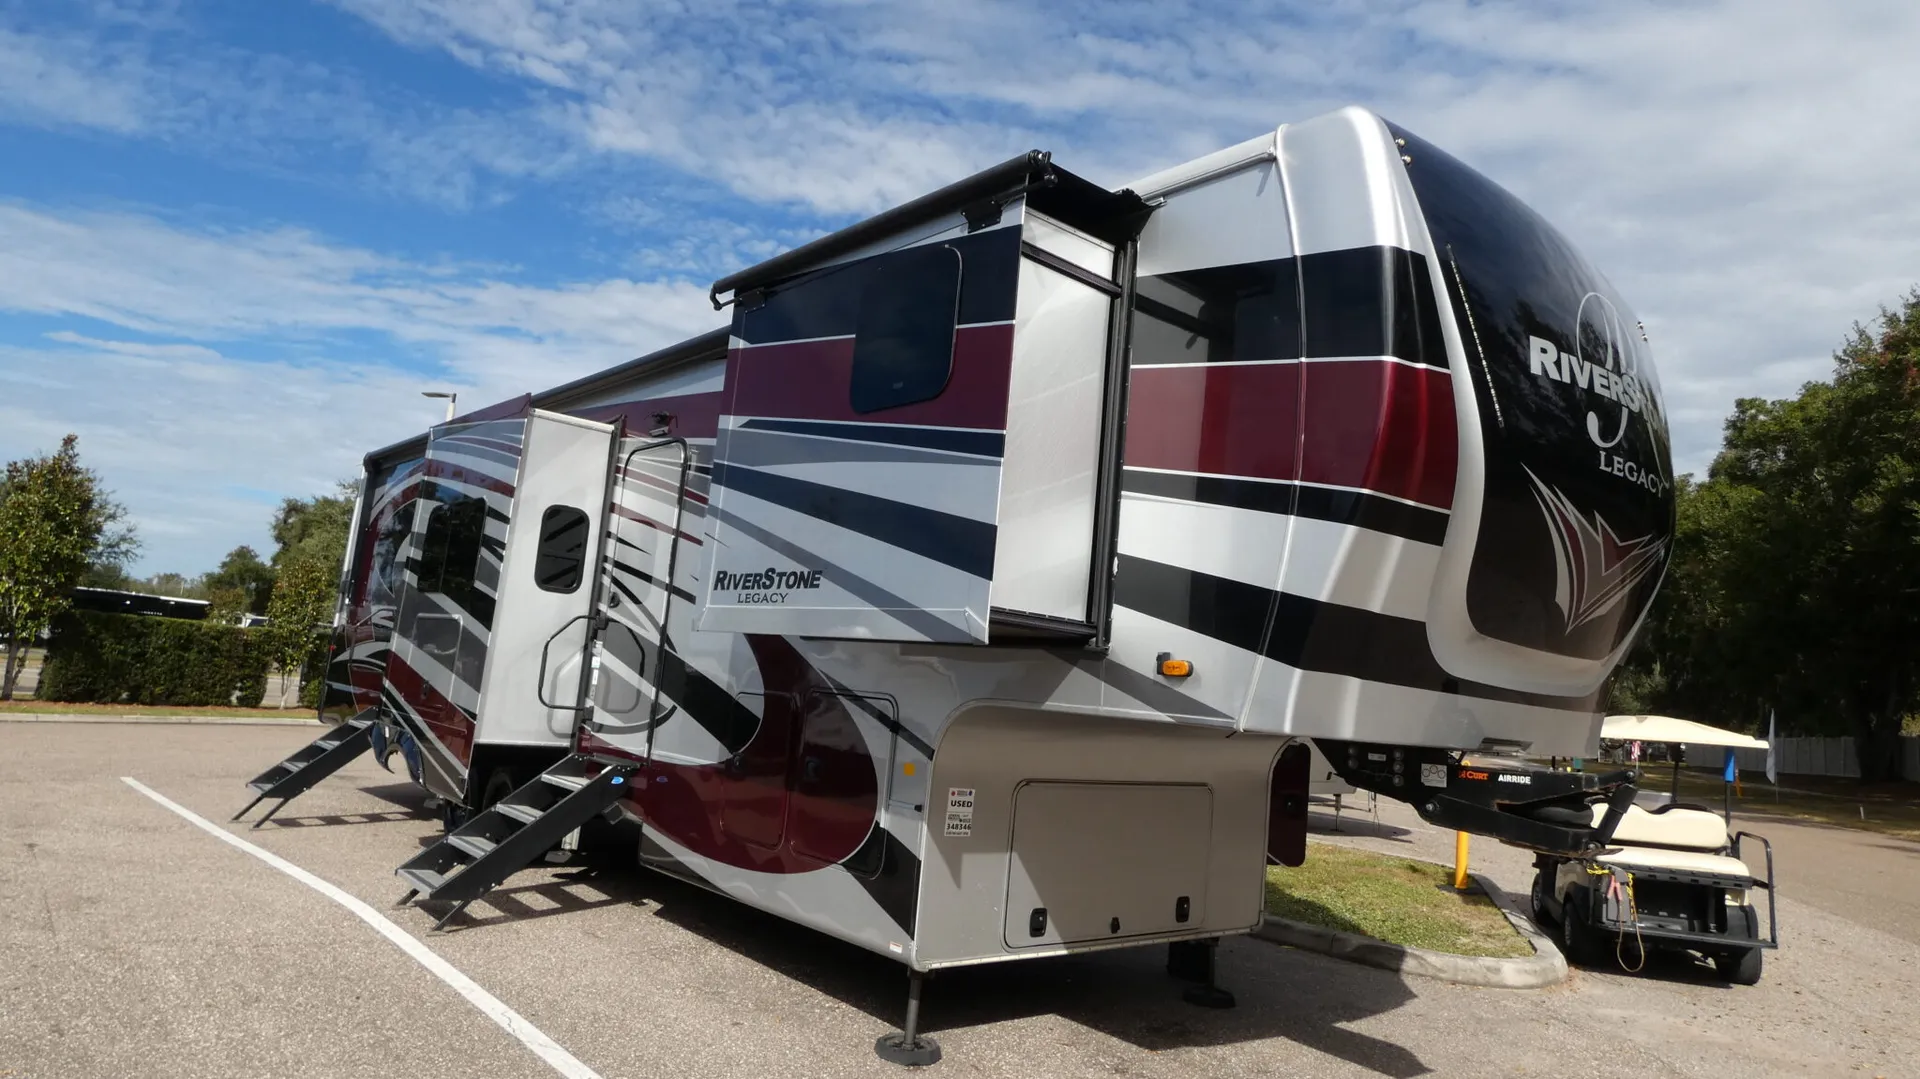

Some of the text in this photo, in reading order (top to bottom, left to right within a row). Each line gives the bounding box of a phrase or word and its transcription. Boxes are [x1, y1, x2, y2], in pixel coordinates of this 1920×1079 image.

[1529, 335, 1669, 446] RIVERS
[1599, 450, 1663, 498] LEGACY
[737, 592, 788, 604] LEGACY
[1498, 774, 1531, 784] AIRRIDE
[951, 800, 973, 808] USED
